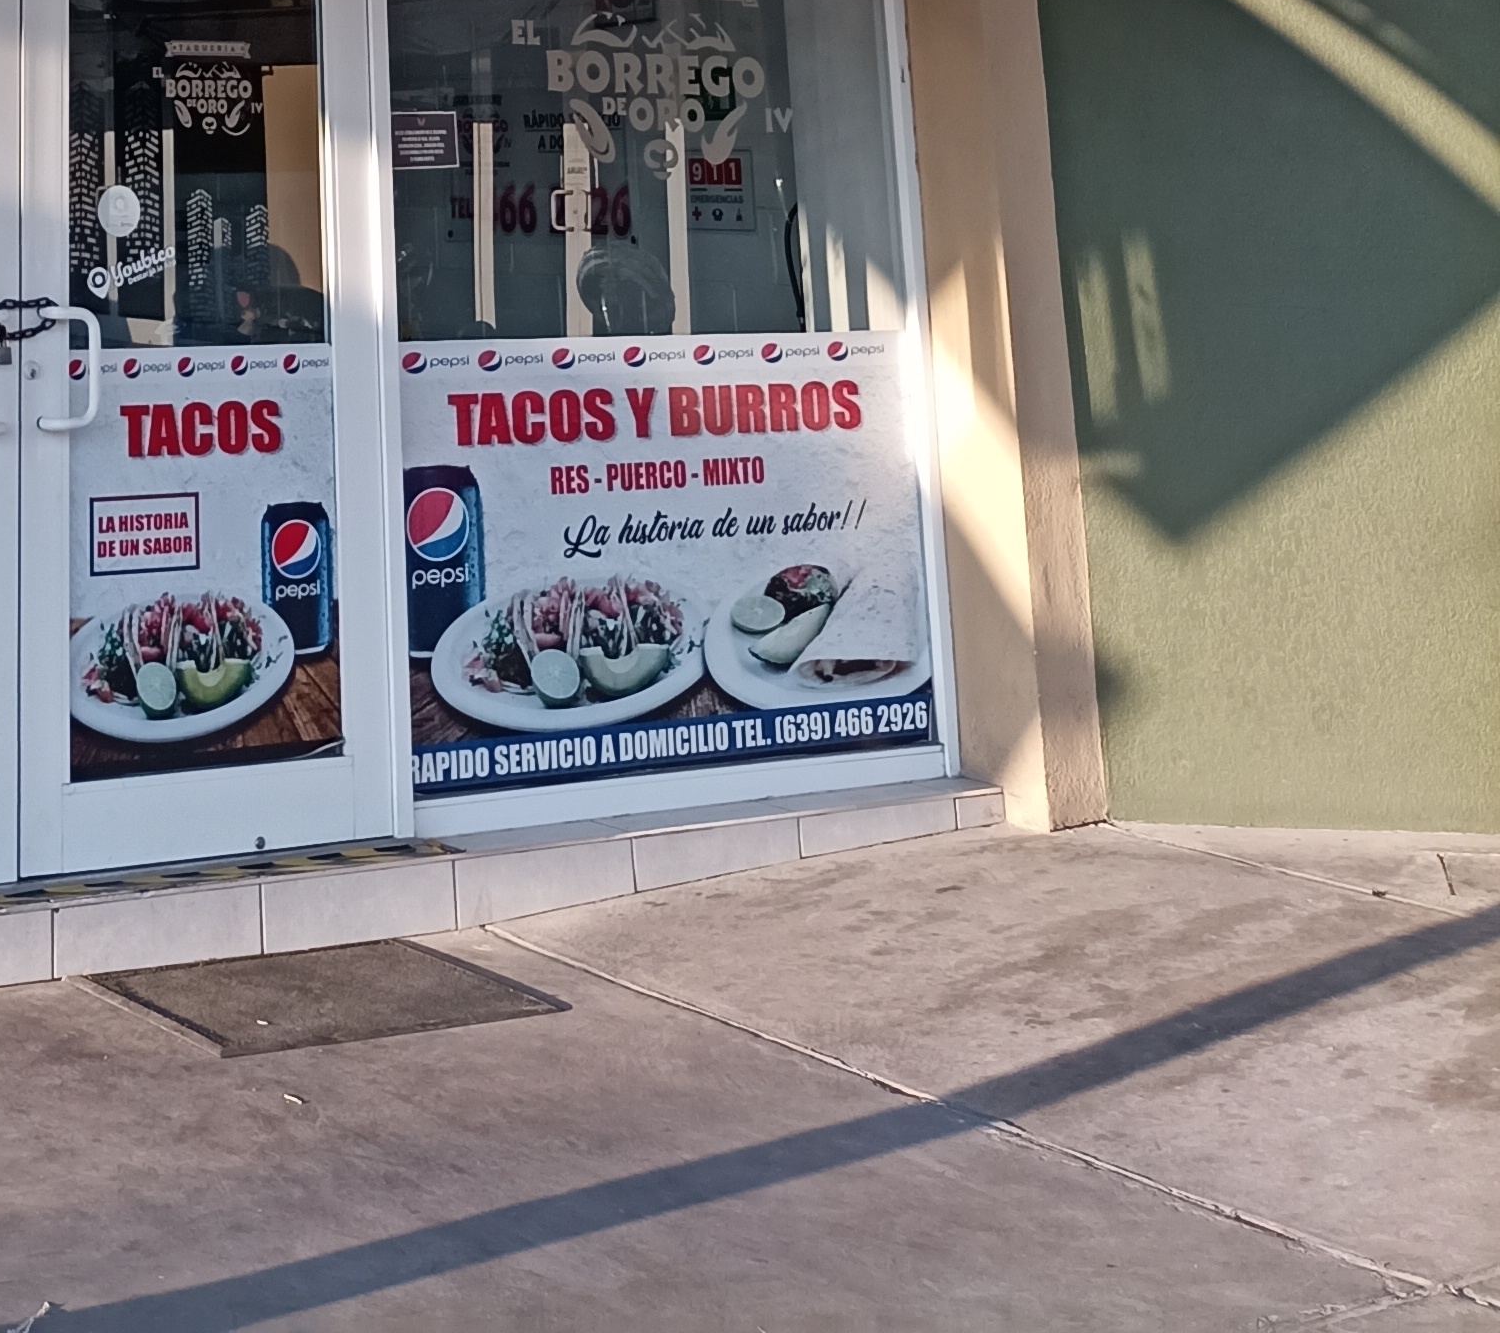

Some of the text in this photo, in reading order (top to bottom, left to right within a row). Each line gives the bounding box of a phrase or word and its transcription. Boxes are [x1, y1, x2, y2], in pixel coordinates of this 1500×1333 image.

[511, 19, 541, 46] EL
[178, 43, 238, 53] TAQUERIA
[152, 66, 165, 79] EL
[546, 49, 766, 99] BORREGO
[165, 79, 252, 99] BORREGO
[187, 98, 228, 115] DE ORO
[250, 101, 264, 115] IV
[602, 96, 627, 117] DE
[764, 107, 794, 134] IV
[110, 246, 176, 287] Youbico
[143, 357, 330, 374] pepsi pepsi pepsi pepsi
[429, 343, 885, 369] pepsi pepsi pepsi pepsi pepsi pepsi pepsi
[448, 380, 863, 447] TACOS Y BURROS
[120, 399, 282, 458] TACOS
[550, 455, 765, 495] RES PUERCO MIXTO
[98, 512, 189, 534] LA HISTORIA
[563, 499, 867, 558] La historia de un sabor!!
[97, 536, 193, 558] DE UN SABOR
[412, 565, 469, 590] pepsi
[275, 580, 321, 601] pepsi
[494, 736, 597, 774] SERVICIO
[601, 736, 616, 764] A
[619, 724, 729, 761] DOMICILIO
[732, 719, 772, 749] TEL.
[775, 711, 831, 745] (639)
[834, 707, 873, 737] 466
[877, 701, 928, 733] 2926
